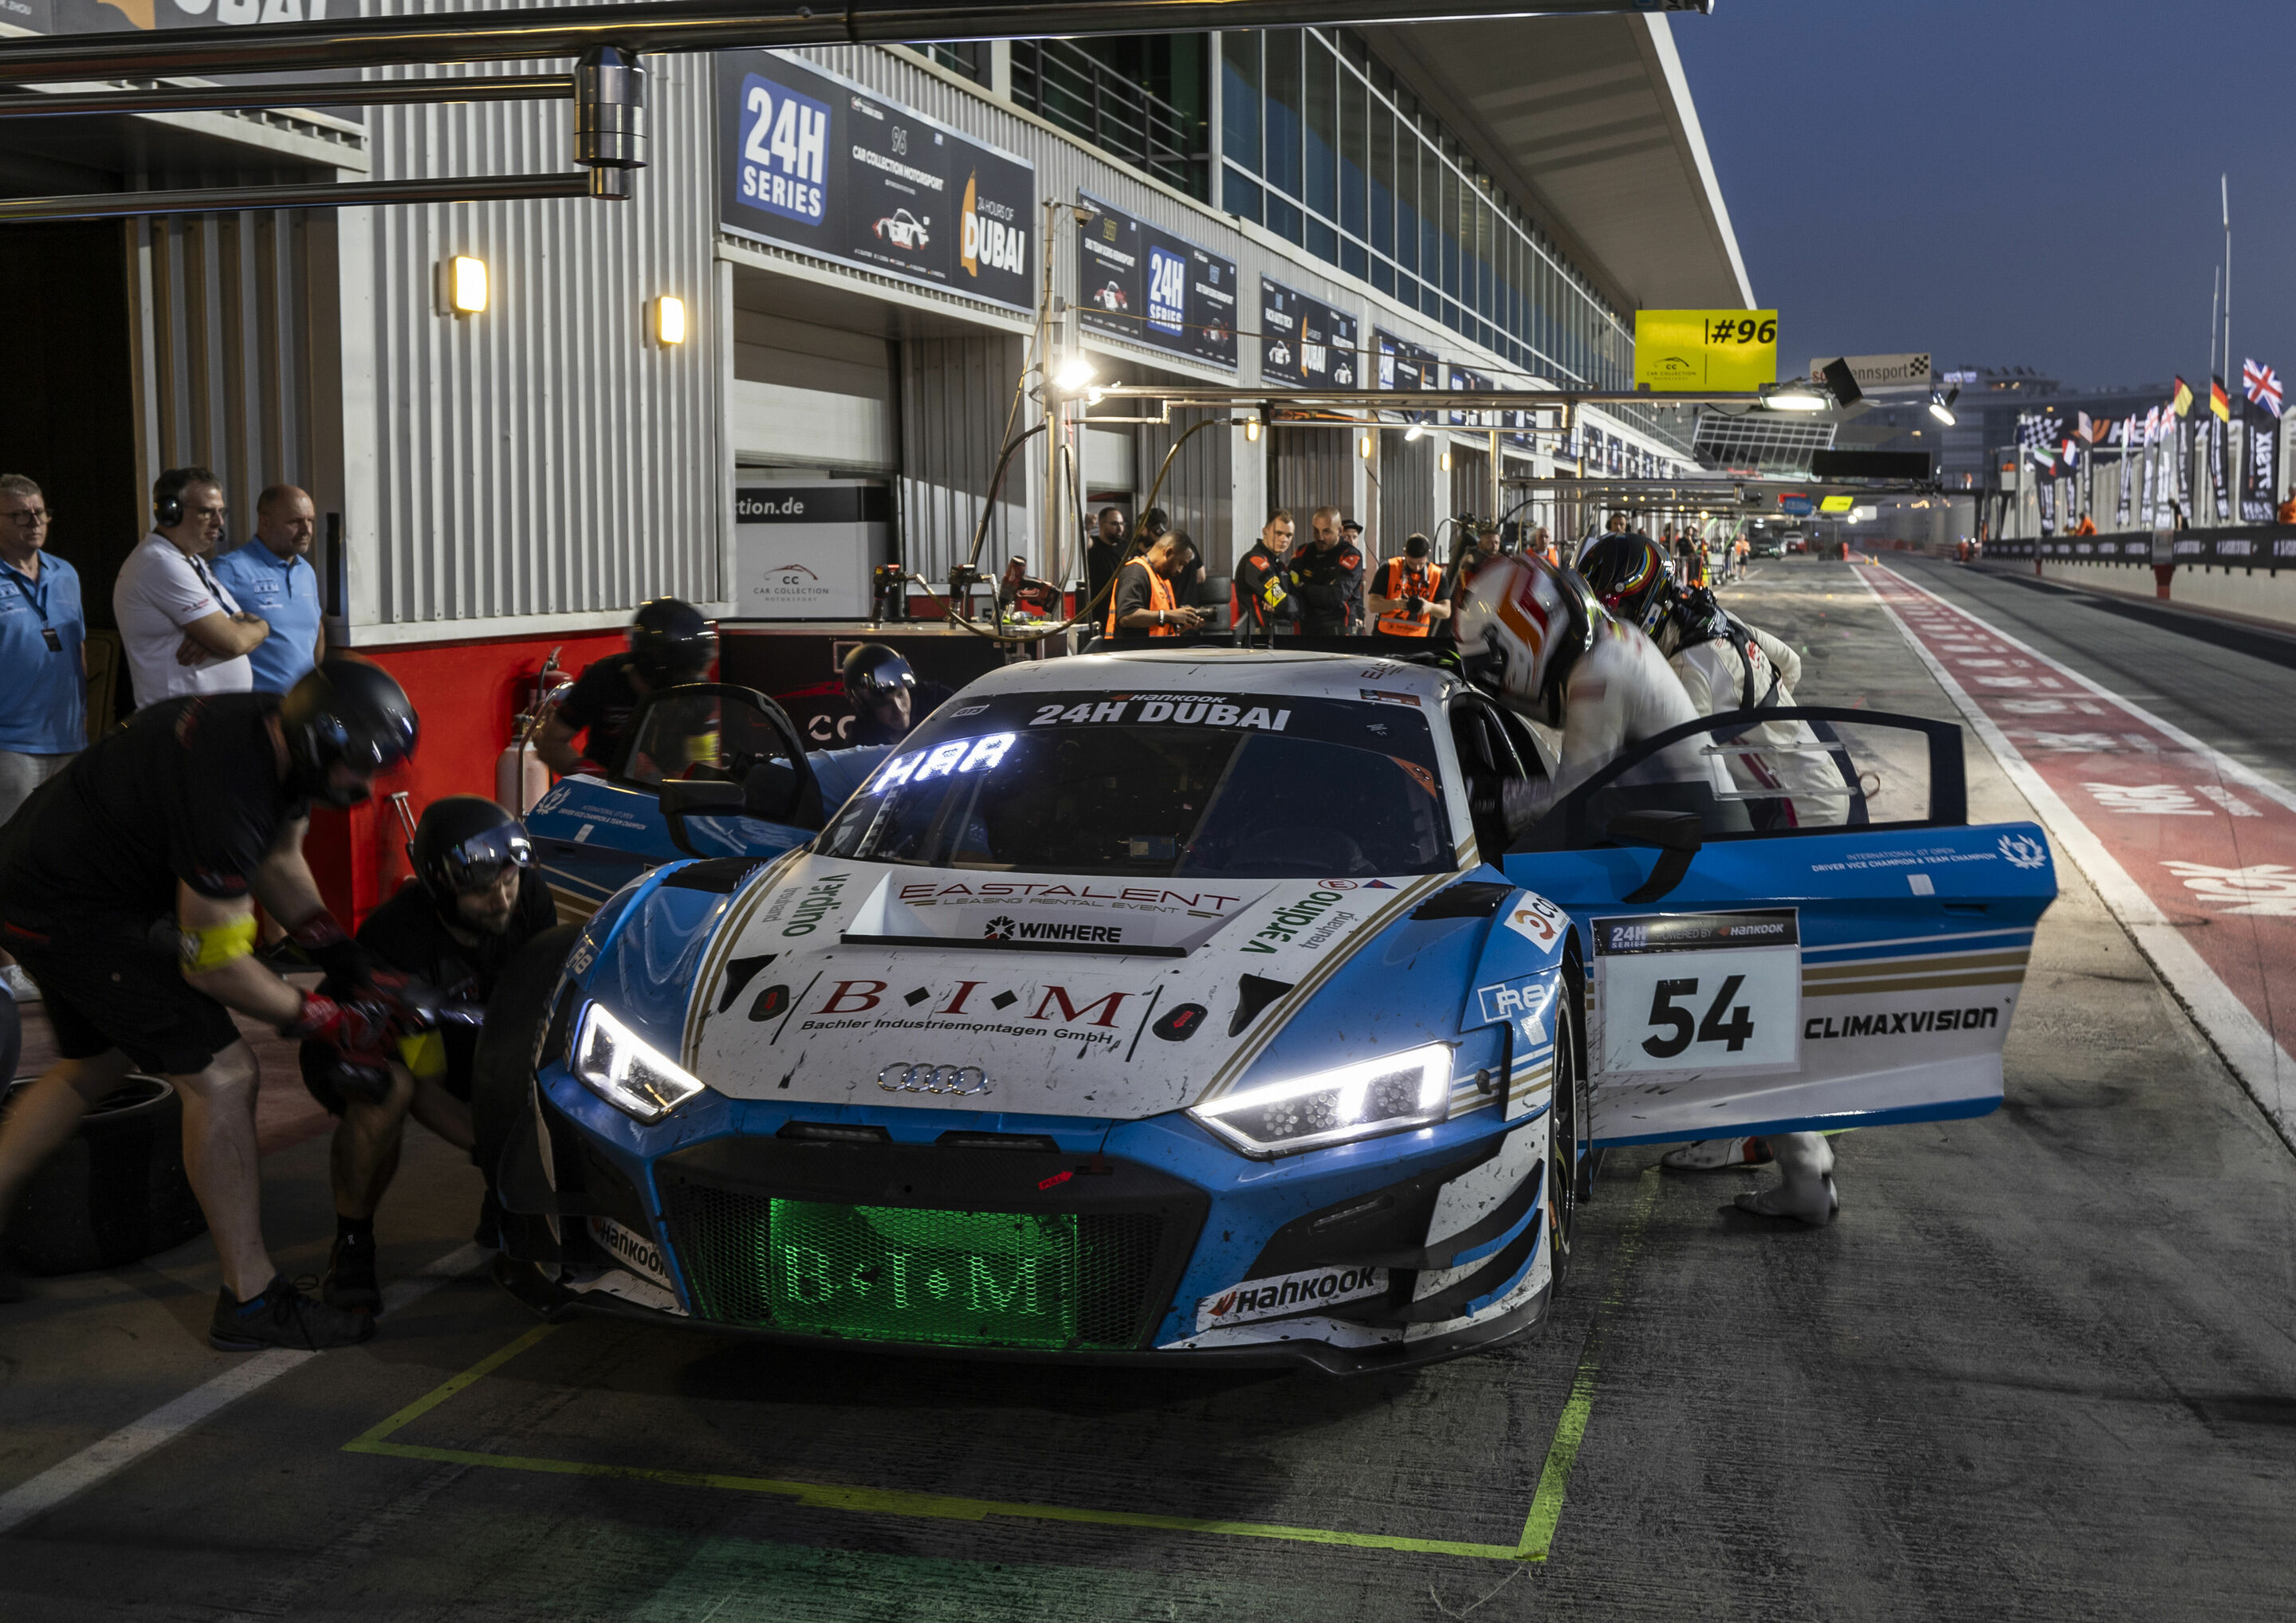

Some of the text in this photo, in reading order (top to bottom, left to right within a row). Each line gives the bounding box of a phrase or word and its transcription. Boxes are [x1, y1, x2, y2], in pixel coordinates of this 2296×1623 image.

[745, 87, 825, 184] 24H
[892, 126, 907, 155] 96
[852, 145, 867, 162] CAR
[867, 150, 903, 176] COLLECTION
[903, 165, 944, 191] MOTORSPORT
[743, 165, 823, 218] SERIES
[985, 198, 1005, 218] HOURS
[1006, 206, 1014, 222] OF
[964, 210, 1025, 276] DUBAI
[1150, 253, 1185, 310] 24H
[1150, 303, 1182, 332] SERIES
[1711, 319, 1776, 344] #96
[1854, 364, 1908, 381] ennsport
[783, 576, 800, 585] CC
[1029, 701, 1292, 732] 24H DUBAI
[584, 813, 606, 823] CHAMPION
[1811, 863, 1846, 873] DRIVER
[1846, 861, 1869, 870] VICE
[1869, 858, 1917, 868] CHAMPION
[1951, 852, 1998, 863] CHAMPION
[1846, 847, 1956, 860] INTERNATIONAL GT OPEN
[762, 886, 803, 923] treuhand
[898, 883, 1240, 910] EASTALENT
[1028, 898, 1104, 908] RENTAL
[1111, 902, 1180, 914] EVENT
[1019, 922, 1122, 944] WINHERE
[1298, 911, 1356, 949] treuhand
[1612, 925, 1648, 941] 24H
[1657, 929, 1699, 940] POWERED
[1700, 928, 1712, 938] BY
[1641, 974, 1755, 1059] 54
[1804, 1007, 1999, 1039] CLIMAXVISION
[800, 1018, 1115, 1045] Bachler Industriemontagen GmbH
